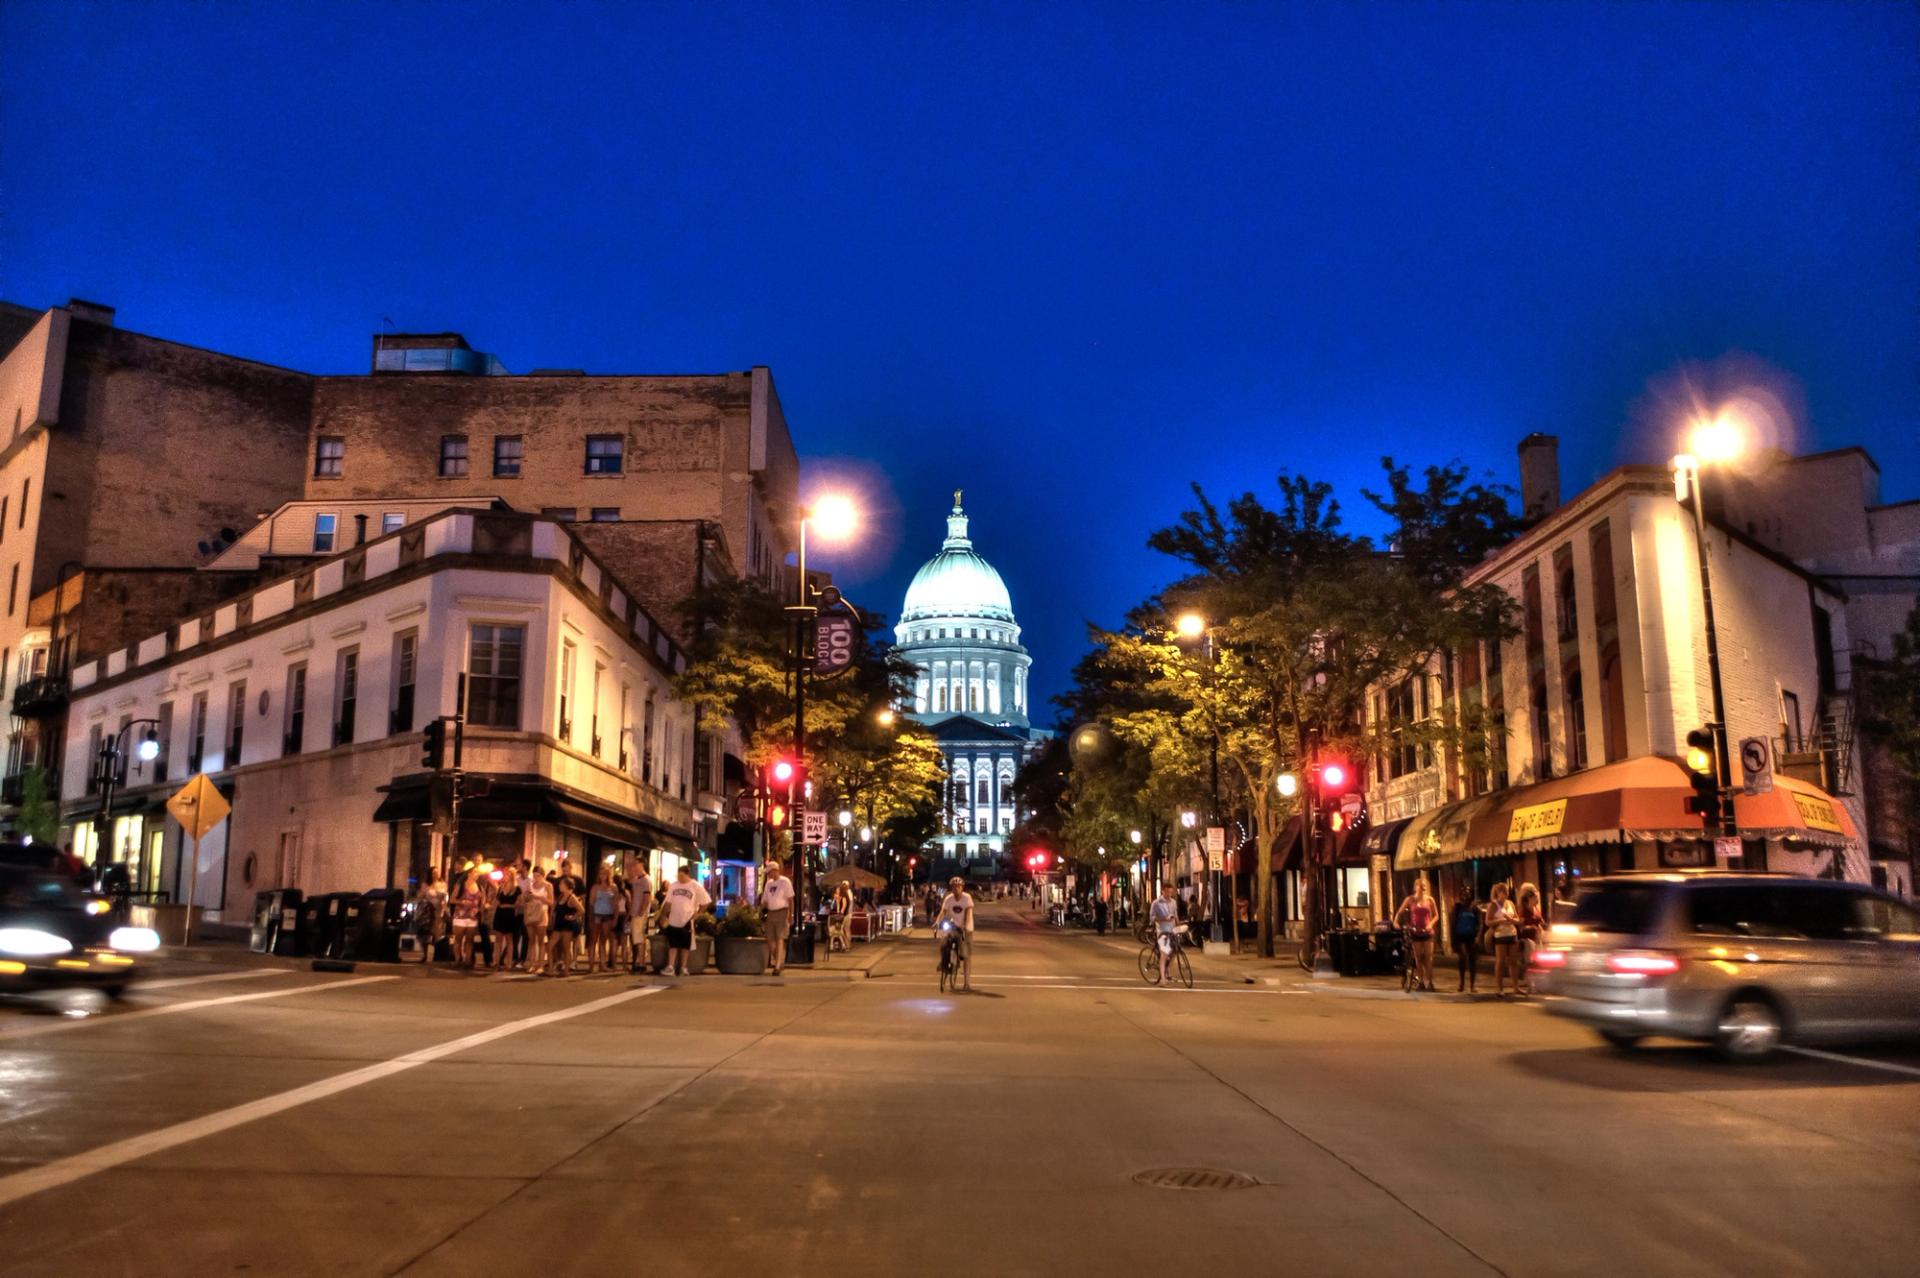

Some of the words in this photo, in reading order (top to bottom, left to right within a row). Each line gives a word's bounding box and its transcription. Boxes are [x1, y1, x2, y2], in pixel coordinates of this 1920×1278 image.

[817, 626, 830, 666] BLOCK
[830, 619, 851, 665] 100
[806, 815, 825, 824] ONE
[806, 824, 824, 832] WAY
[1211, 860, 1221, 869] 15
